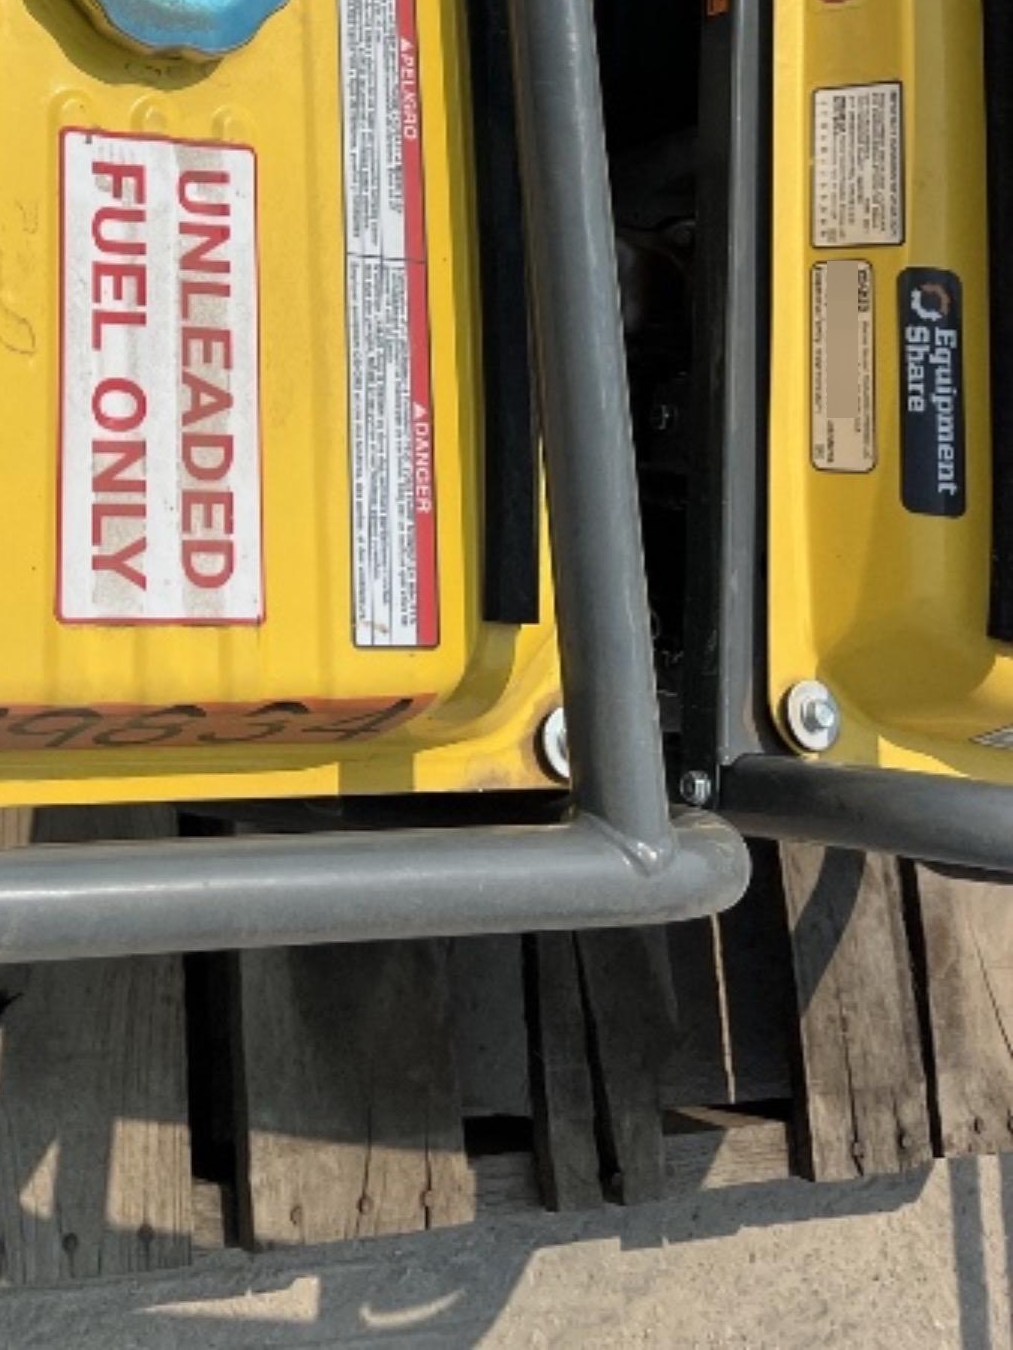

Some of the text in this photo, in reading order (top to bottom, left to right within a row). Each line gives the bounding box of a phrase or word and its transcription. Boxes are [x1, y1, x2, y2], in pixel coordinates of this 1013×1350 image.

[400, 53, 419, 140] PELIGRO
[91, 160, 148, 592] FUEL ONLY
[177, 169, 235, 590] UNLEADED
[904, 324, 931, 413] Share
[931, 326, 960, 496] Equipment
[414, 421, 431, 514] DANGER
